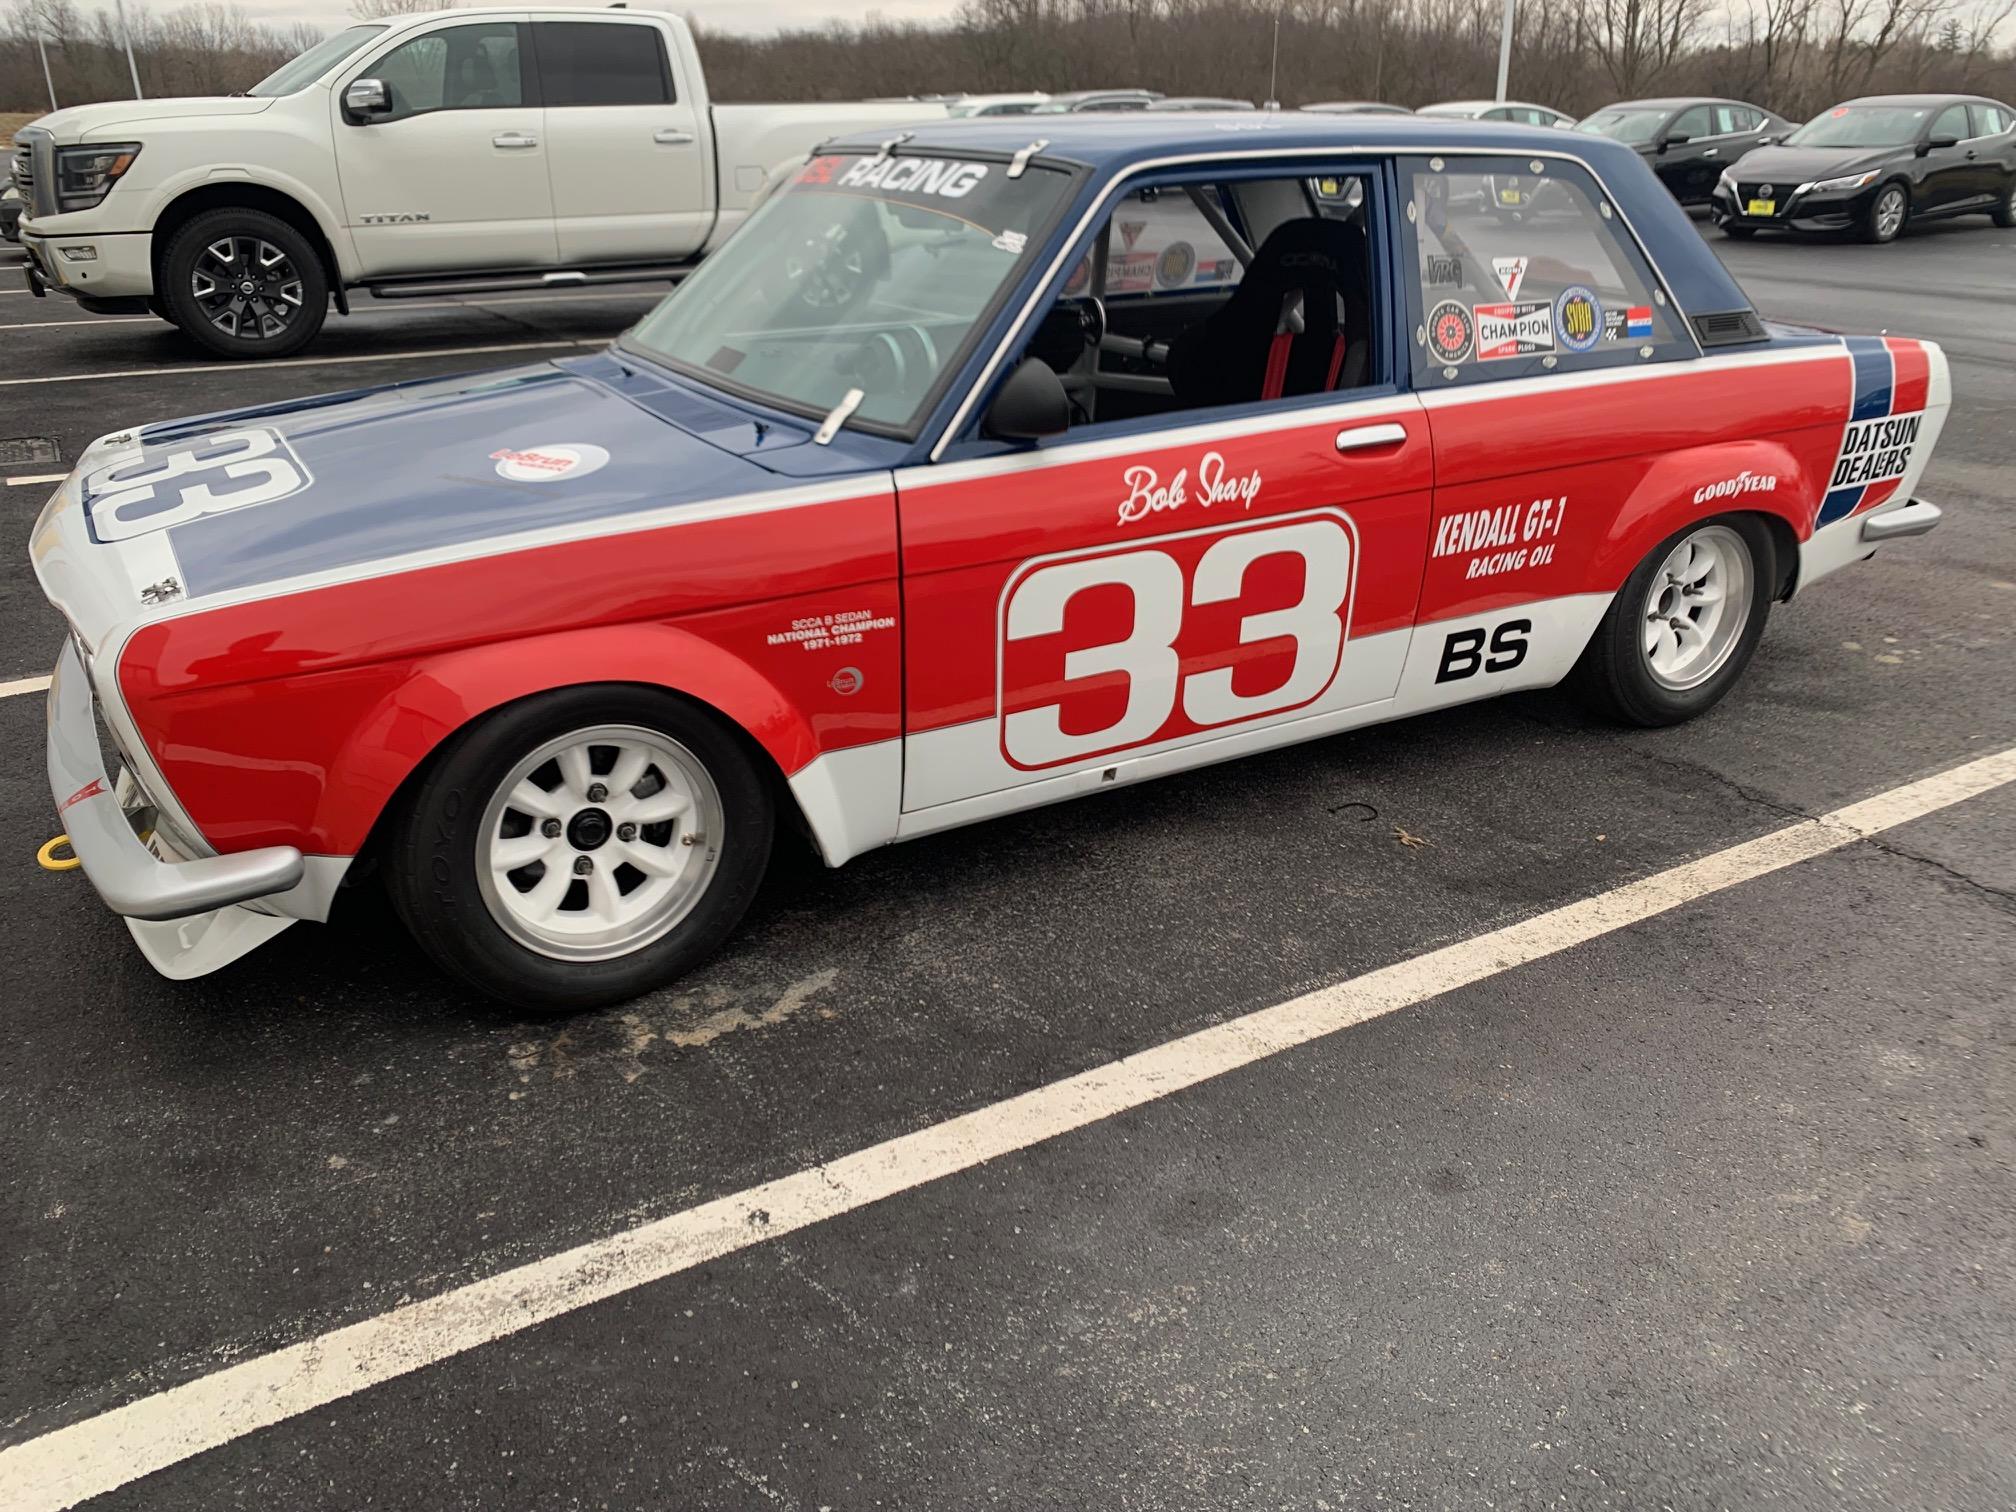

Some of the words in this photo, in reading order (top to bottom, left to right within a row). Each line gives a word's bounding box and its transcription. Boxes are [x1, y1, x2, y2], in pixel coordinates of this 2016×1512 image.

[838, 156, 988, 198] RACING
[360, 211, 430, 224] TITAN
[1481, 319, 1551, 341] CHAMPION
[1842, 416, 1922, 456] DATSUN
[88, 428, 303, 541] 33
[1831, 446, 1912, 487] DEALERS
[1116, 465, 1188, 527] Bob
[1195, 451, 1262, 511] Sharp
[1432, 503, 1521, 558] KENDALL
[1522, 495, 1568, 542] GT-1
[1465, 548, 1528, 580] RACING
[1528, 543, 1556, 567] OIL
[767, 626, 829, 645] NATIONAL
[831, 616, 895, 636] CHAMPION
[791, 616, 823, 631] SCCA
[824, 614, 834, 626] B
[834, 609, 872, 623] SEDAN
[803, 632, 863, 651] 1971-1972
[1003, 520, 1350, 766] 33
[1434, 618, 1532, 685] BS
